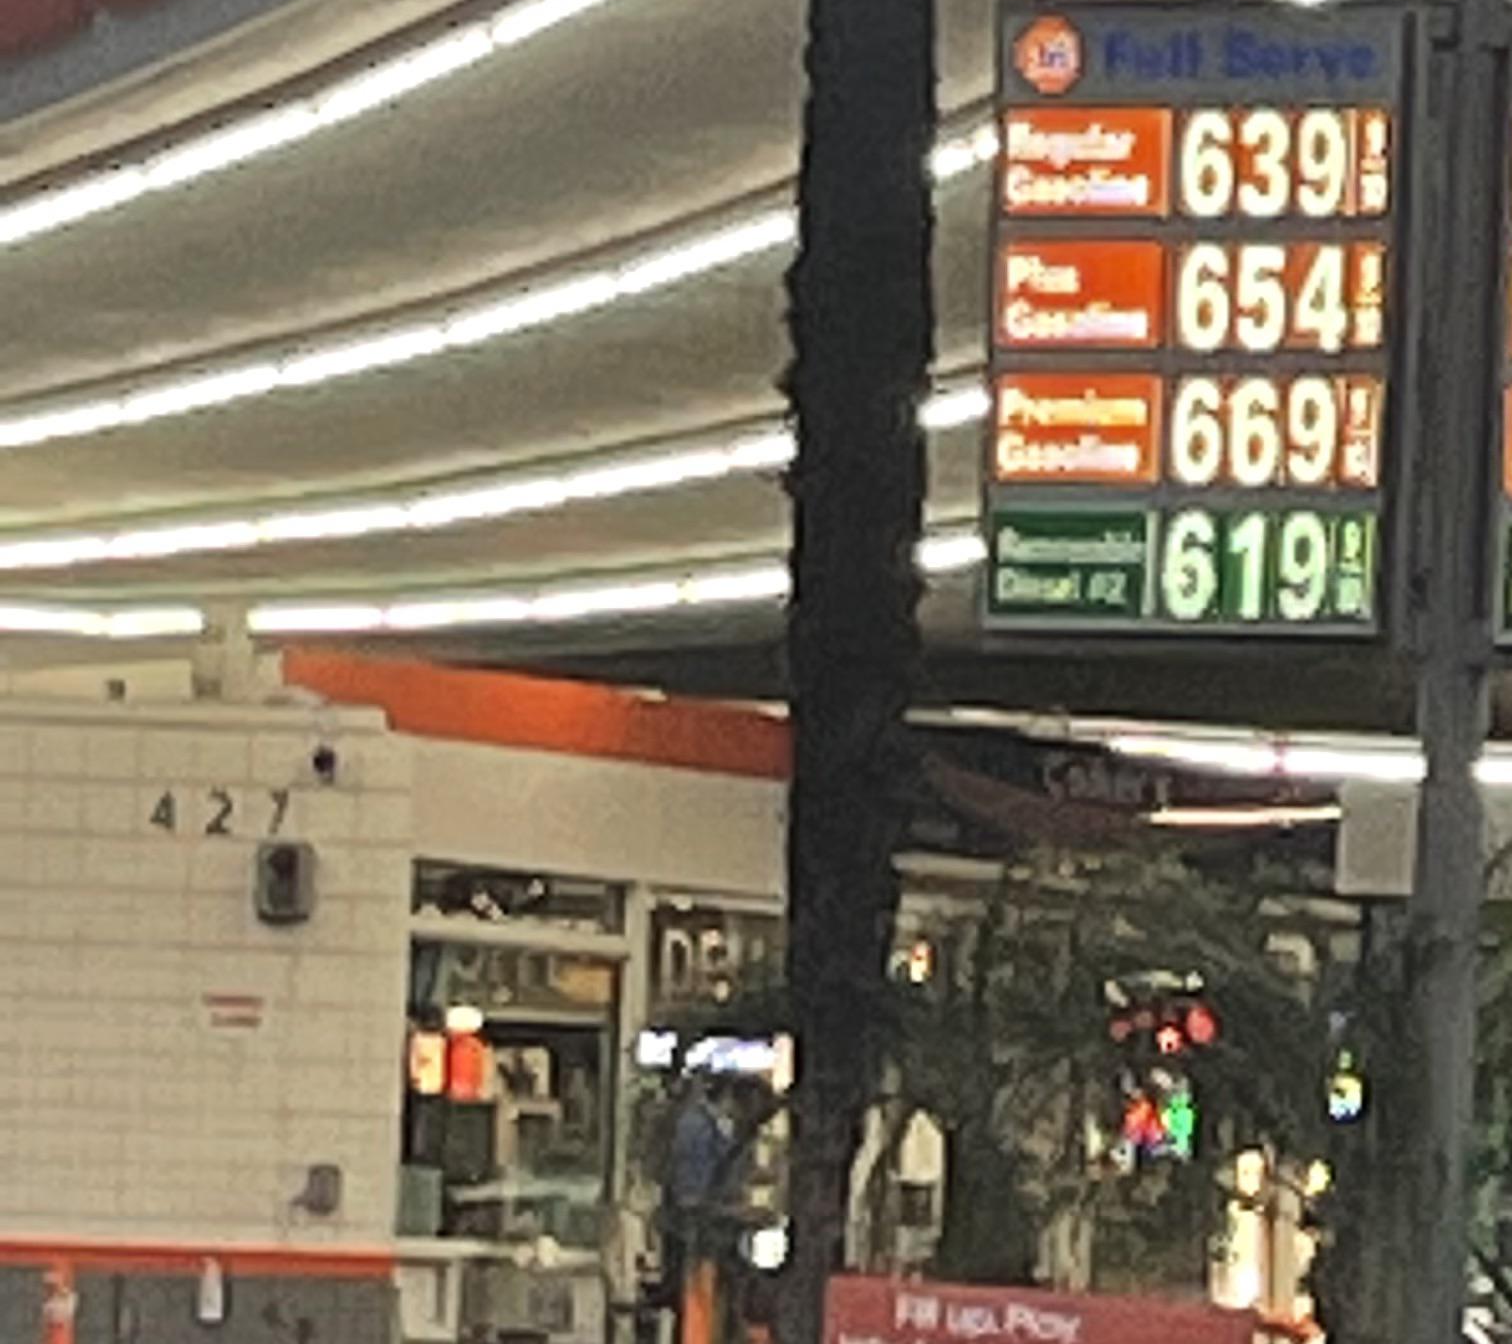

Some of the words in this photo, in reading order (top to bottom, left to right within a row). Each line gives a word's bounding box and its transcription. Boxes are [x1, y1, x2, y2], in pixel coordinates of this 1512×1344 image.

[1105, 29, 1202, 78] Full
[1224, 27, 1376, 80] Serve
[1181, 110, 1346, 217] 639
[1179, 244, 1347, 351] 654
[1170, 376, 1336, 485] 669
[1162, 511, 1327, 621] 619
